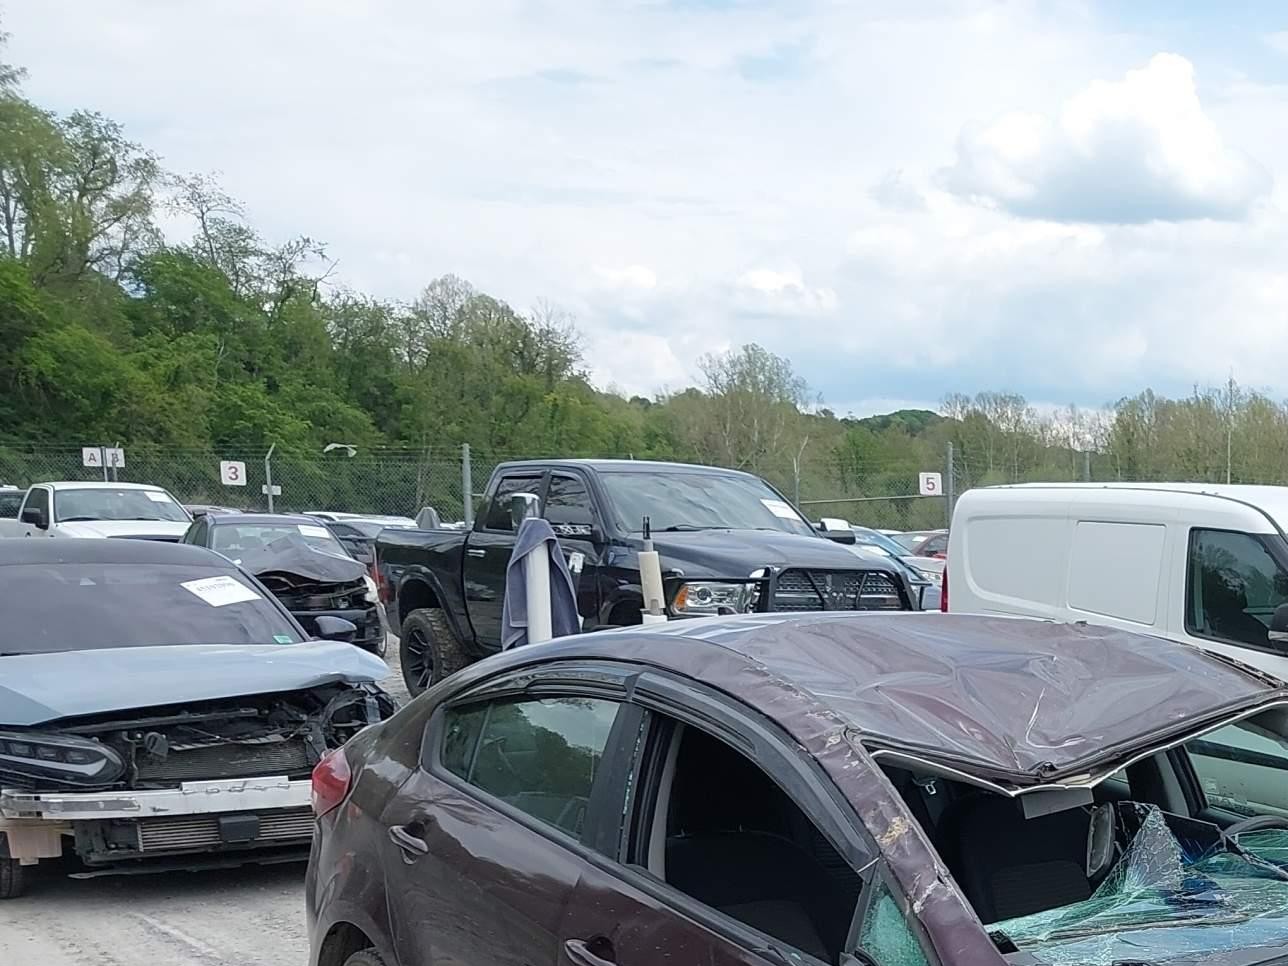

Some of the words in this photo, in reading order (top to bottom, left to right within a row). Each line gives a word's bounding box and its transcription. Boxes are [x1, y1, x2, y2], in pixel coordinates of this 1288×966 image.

[88, 452, 97, 462] A
[228, 466, 239, 481] 3
[926, 477, 936, 491] 5
